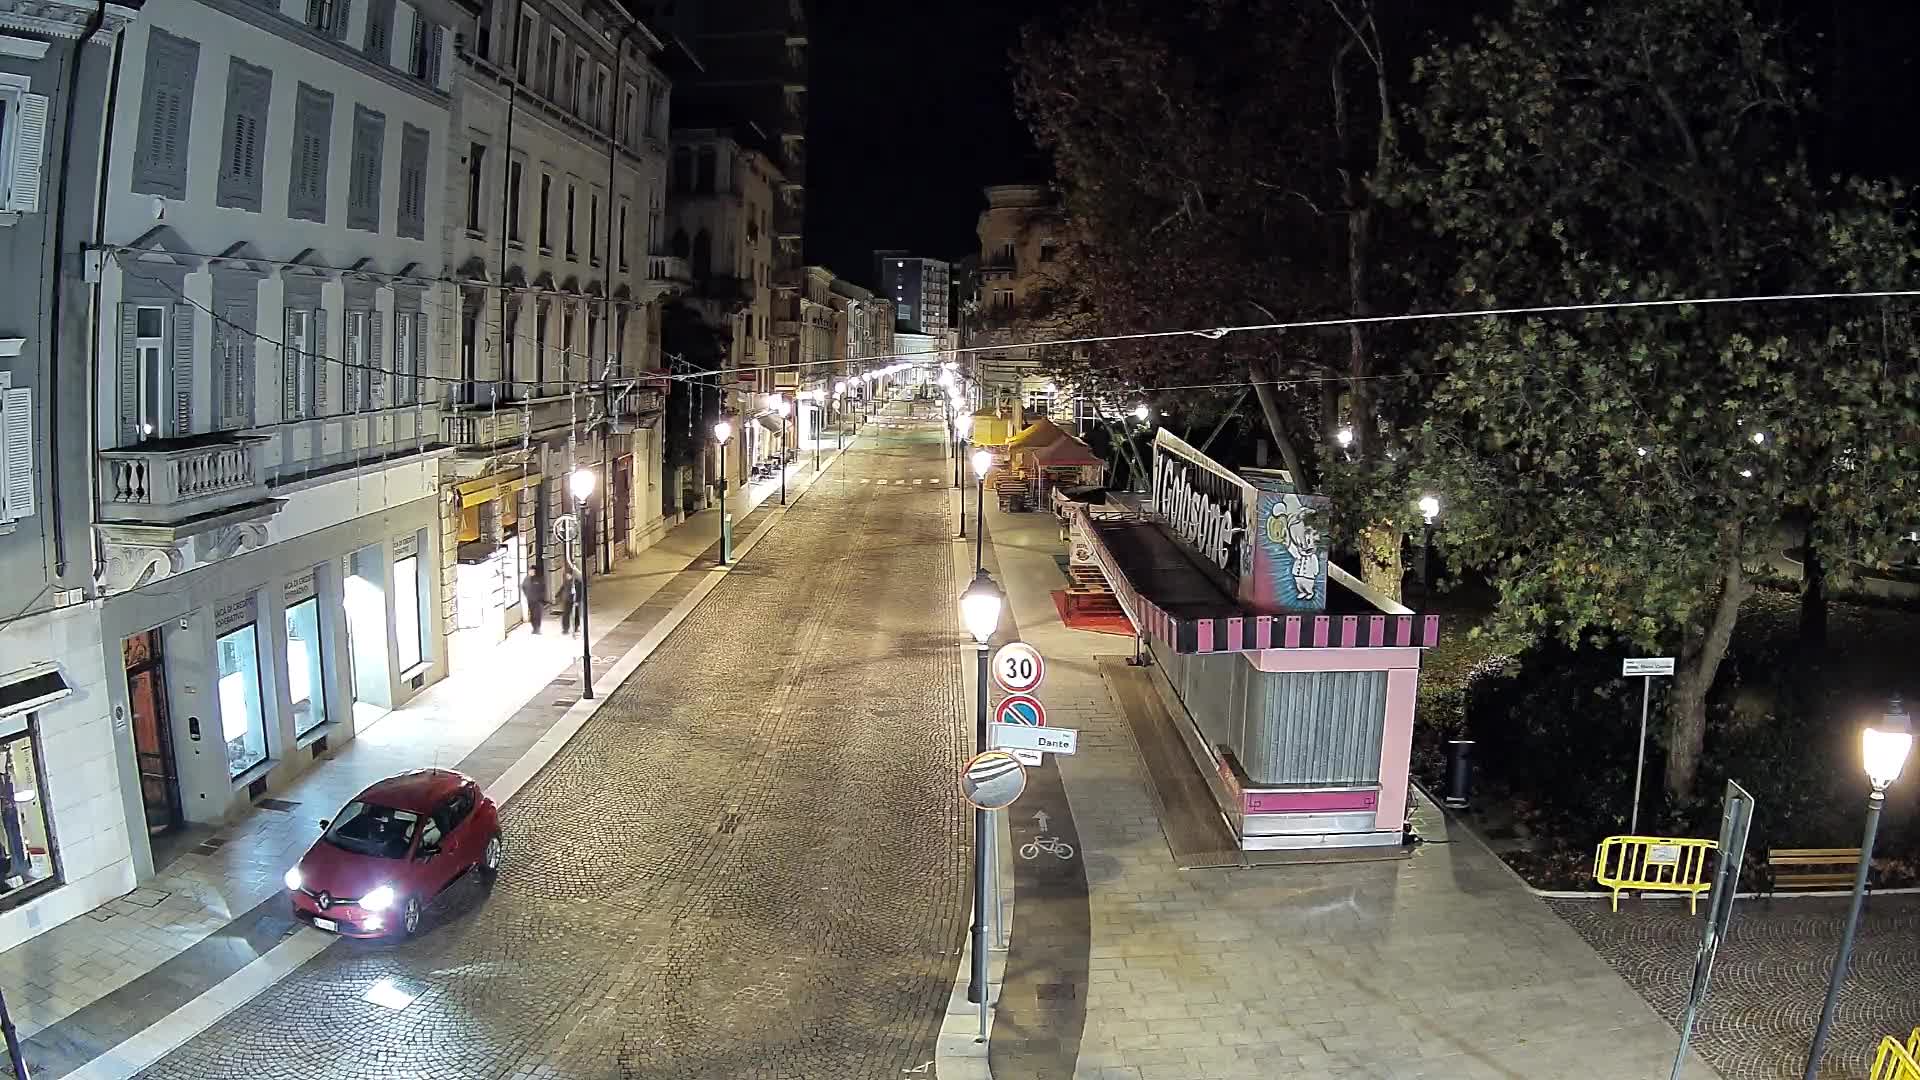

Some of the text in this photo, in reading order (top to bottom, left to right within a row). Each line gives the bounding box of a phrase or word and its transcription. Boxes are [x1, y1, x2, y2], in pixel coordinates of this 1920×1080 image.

[1162, 458, 1233, 570] Golosone
[1006, 658, 1032, 679] 30
[1038, 737, 1069, 748] Dante
